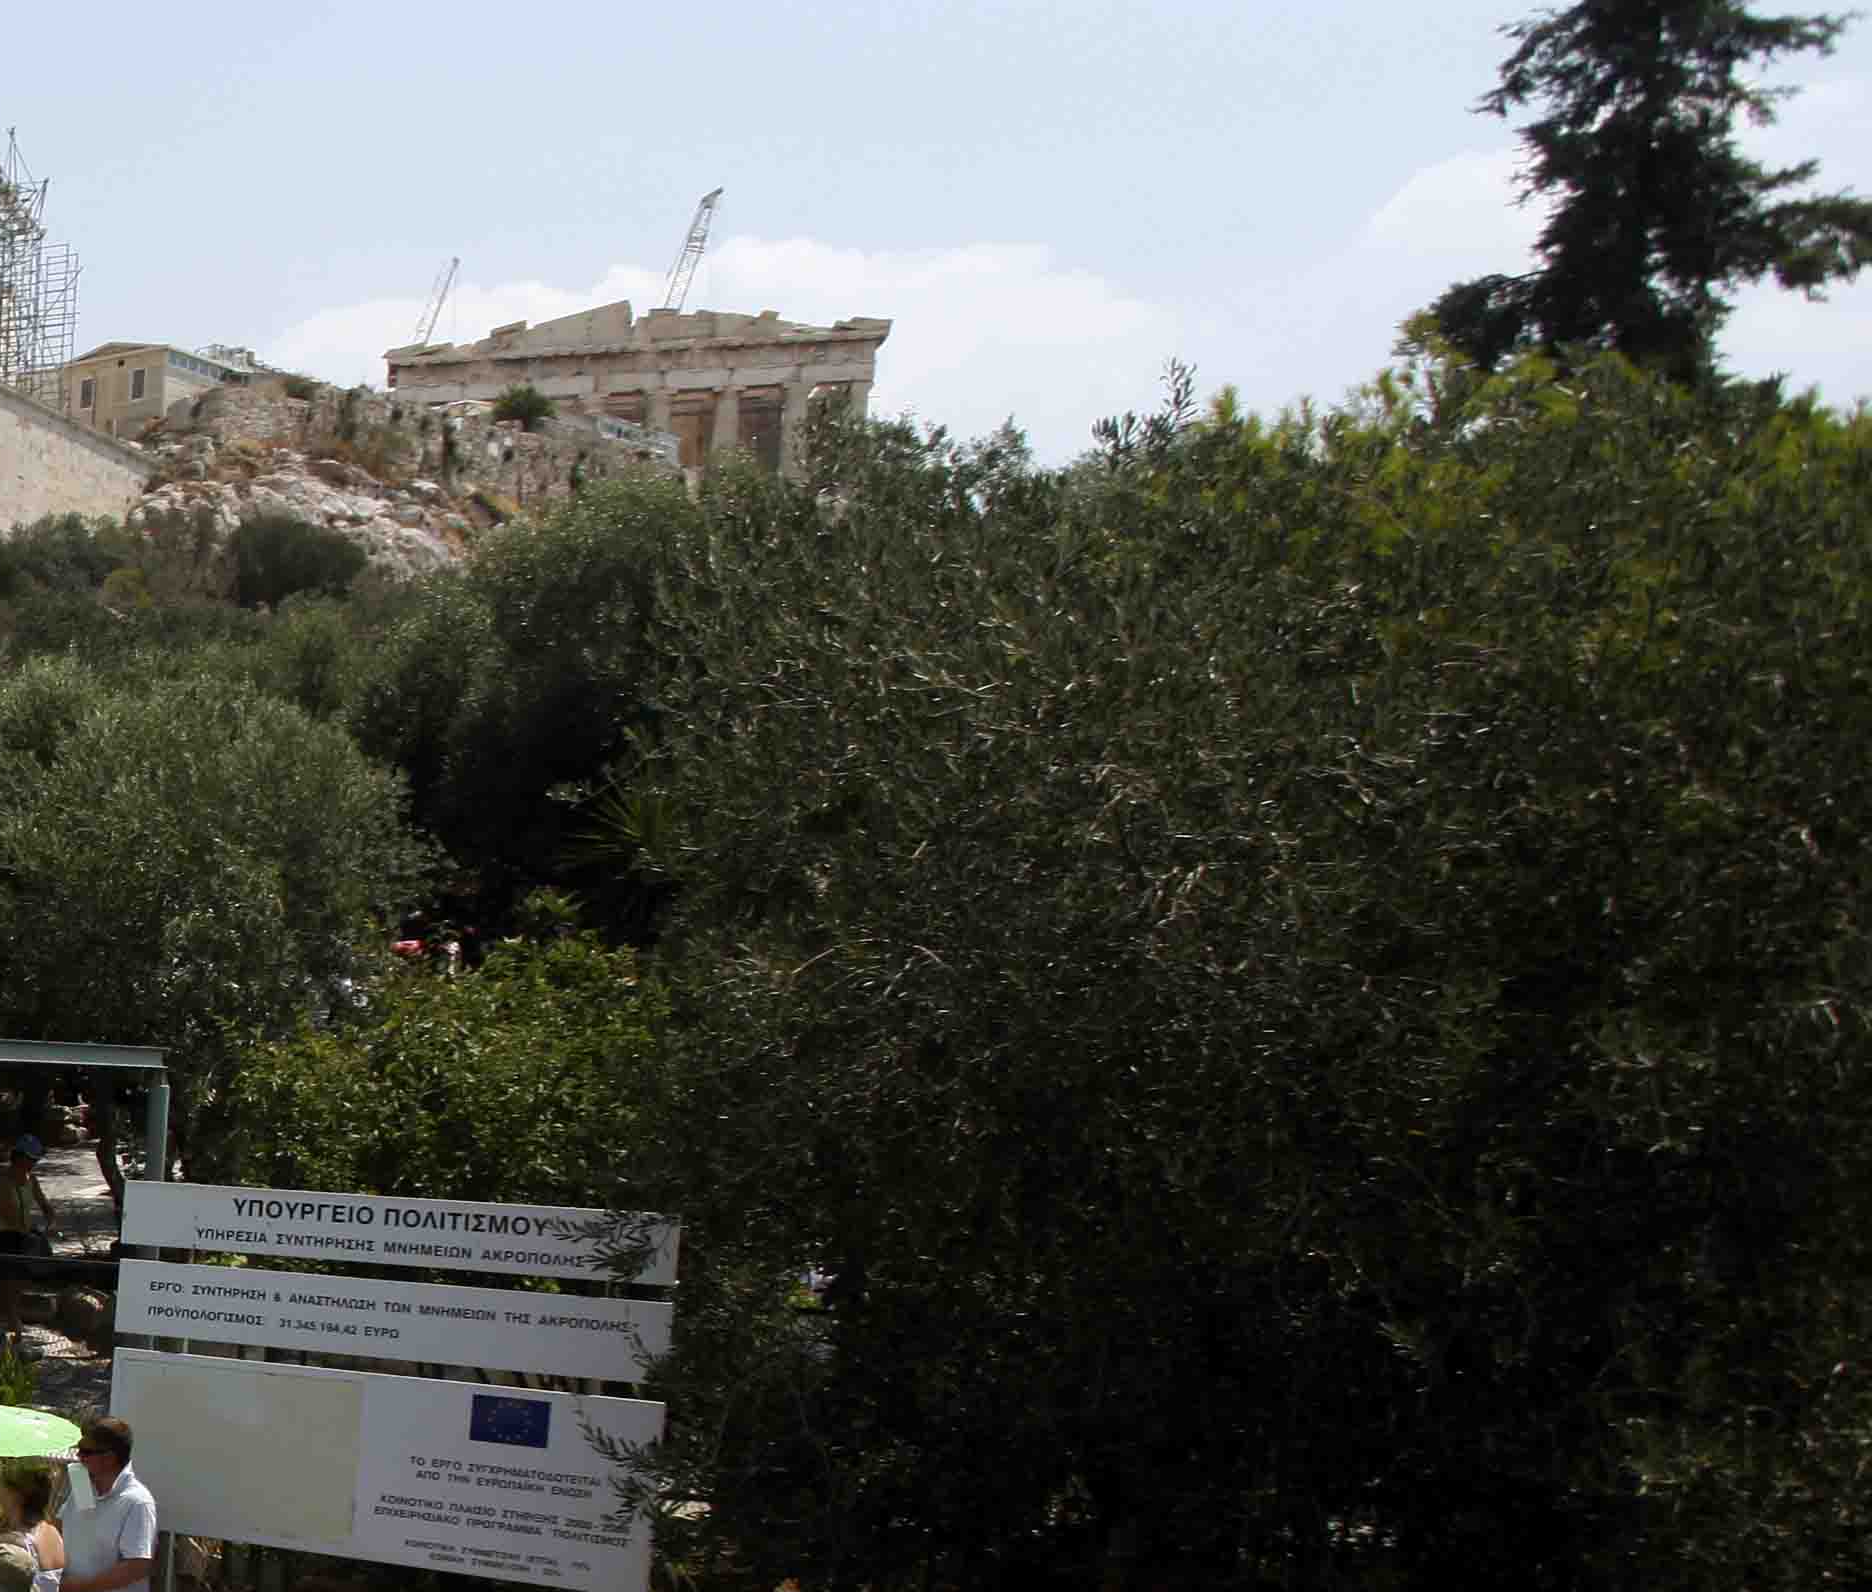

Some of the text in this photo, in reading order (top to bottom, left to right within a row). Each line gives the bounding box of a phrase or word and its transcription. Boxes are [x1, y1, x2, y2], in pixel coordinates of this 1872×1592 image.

[232, 1198, 547, 1237] ΥΠΟΥΡΓΕΙΟ ΠΟΛΙΤΙΣΜΟΥ
[195, 1227, 586, 1268] ΥΠΗΡΕΣΙΑ ΣΥΝΤΗΡΗΣΗΣ ΜΝΗΜΕΙΩΝ ΑΚΡΟΠΟΛΗΣ
[191, 1284, 267, 1301] ΣΥΝΤΗΡΗΣΗ
[288, 1293, 377, 1311] ΑΝΑΣΤΗΛΩΣΗ
[383, 1301, 412, 1313] ΤΩΝ
[419, 1304, 497, 1321] ΜΝΗΜΕΙΩΝ
[504, 1311, 532, 1325] ΤΗΣ
[364, 1326, 401, 1340] ΕΥΡΩ
[409, 1456, 426, 1466] ΤΟ
[431, 1458, 463, 1471] ΕΡΓΟ
[415, 1470, 441, 1481] ΑΠΟ
